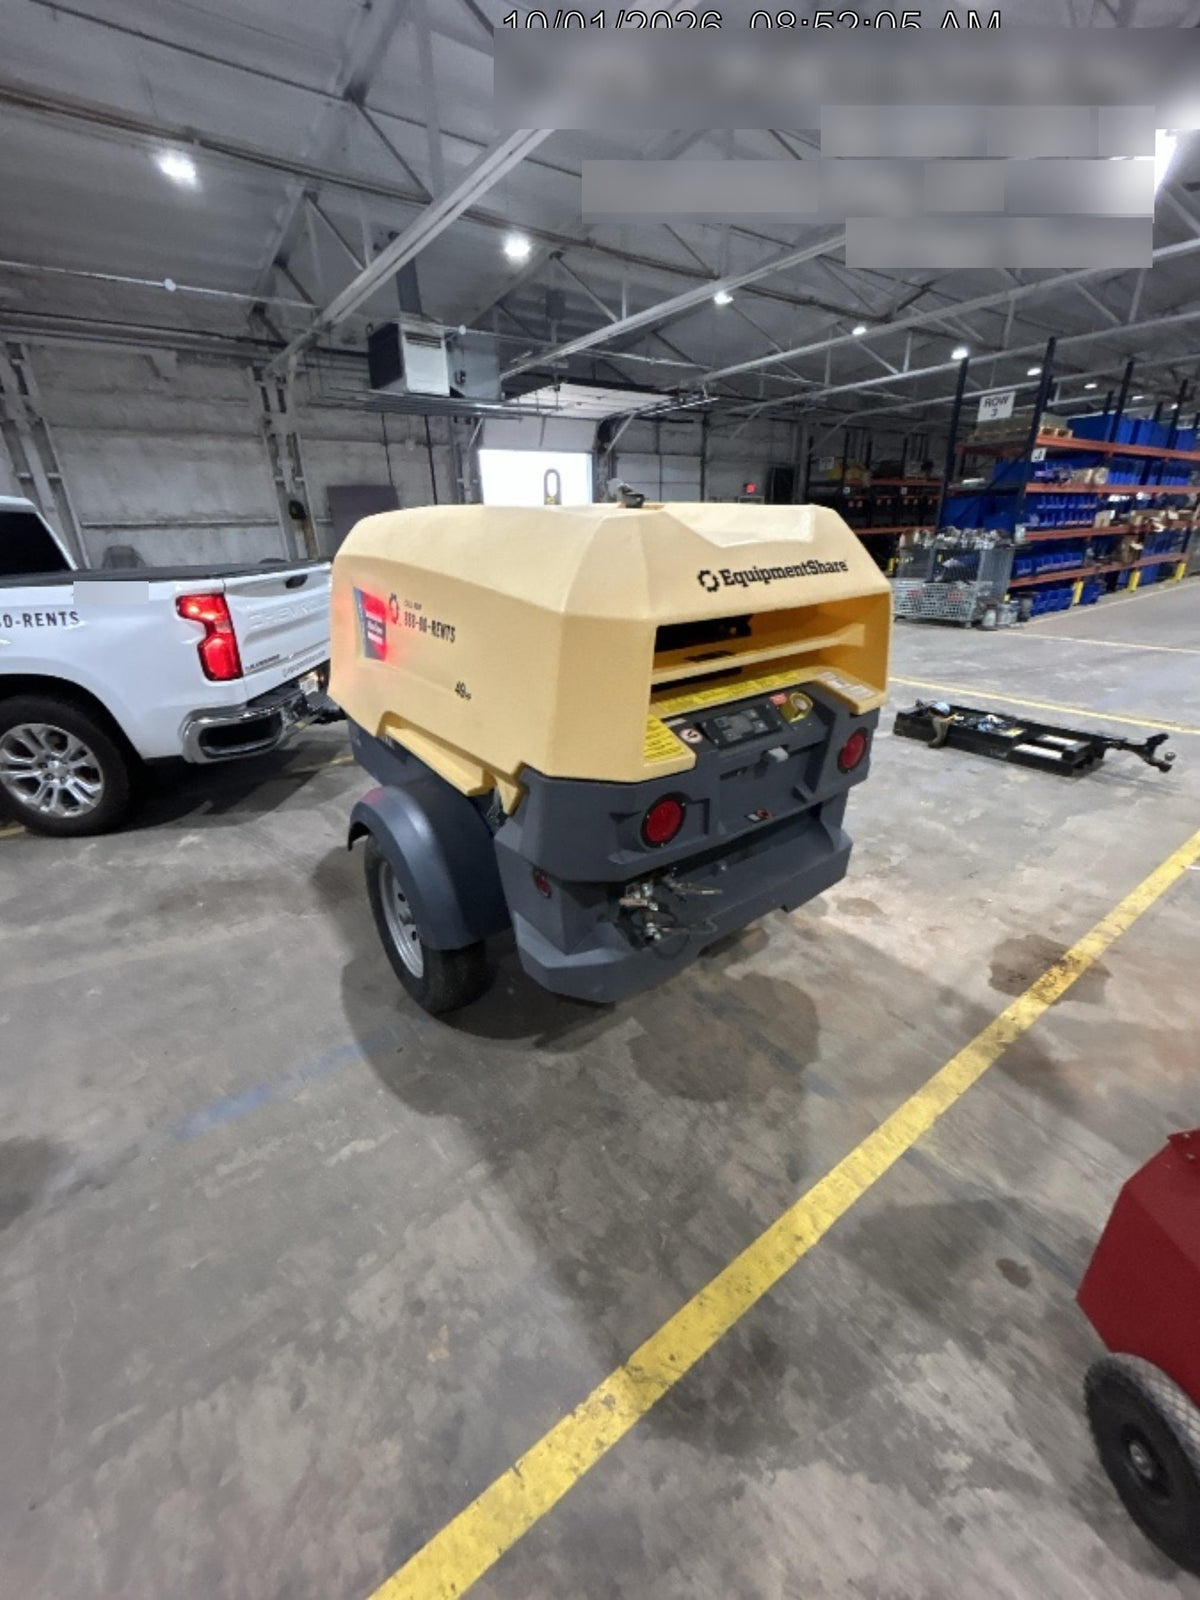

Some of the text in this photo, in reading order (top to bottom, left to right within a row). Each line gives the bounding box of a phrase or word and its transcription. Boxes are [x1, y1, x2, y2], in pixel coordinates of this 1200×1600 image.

[984, 395, 1010, 407] ROW
[719, 559, 849, 587] EquipmentShare
[0, 611, 80, 629] 0-RENTS
